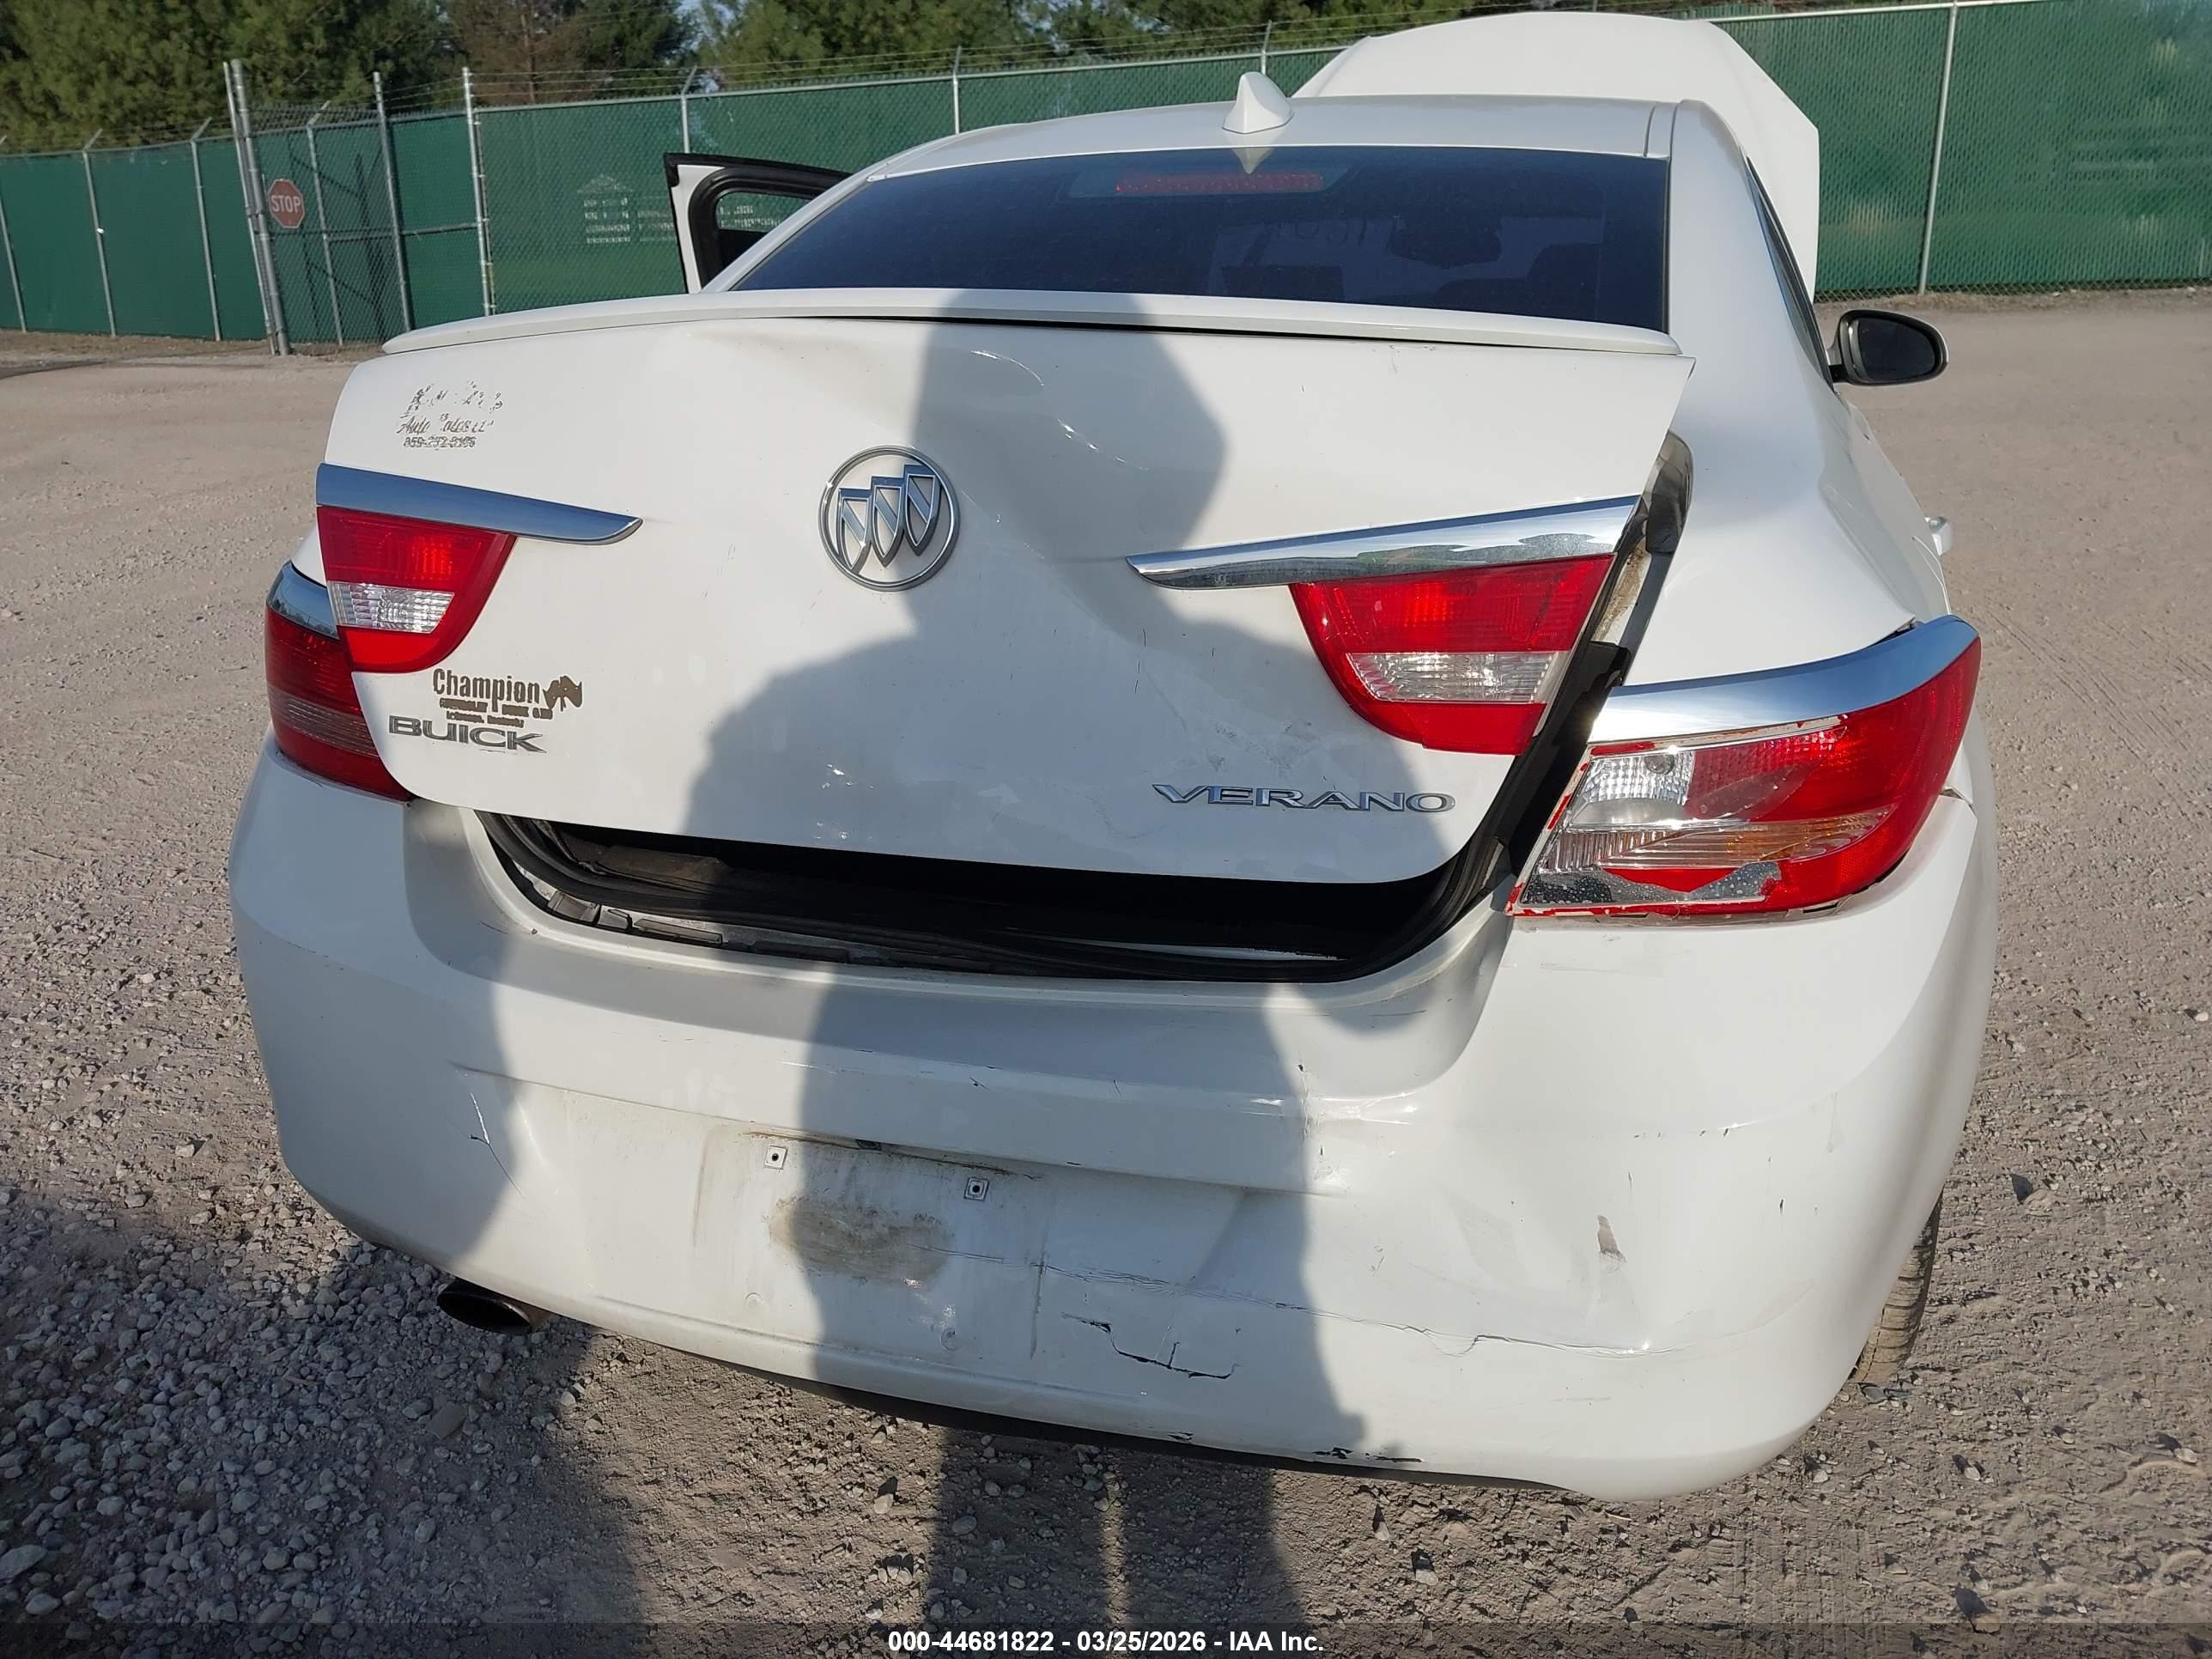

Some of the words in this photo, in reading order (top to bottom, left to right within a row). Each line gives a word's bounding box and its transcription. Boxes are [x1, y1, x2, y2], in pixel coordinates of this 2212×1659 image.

[270, 195, 301, 213] STOP
[433, 668, 540, 712] Champion
[388, 714, 547, 754] BUICK
[1151, 783, 1456, 813] VERANO
